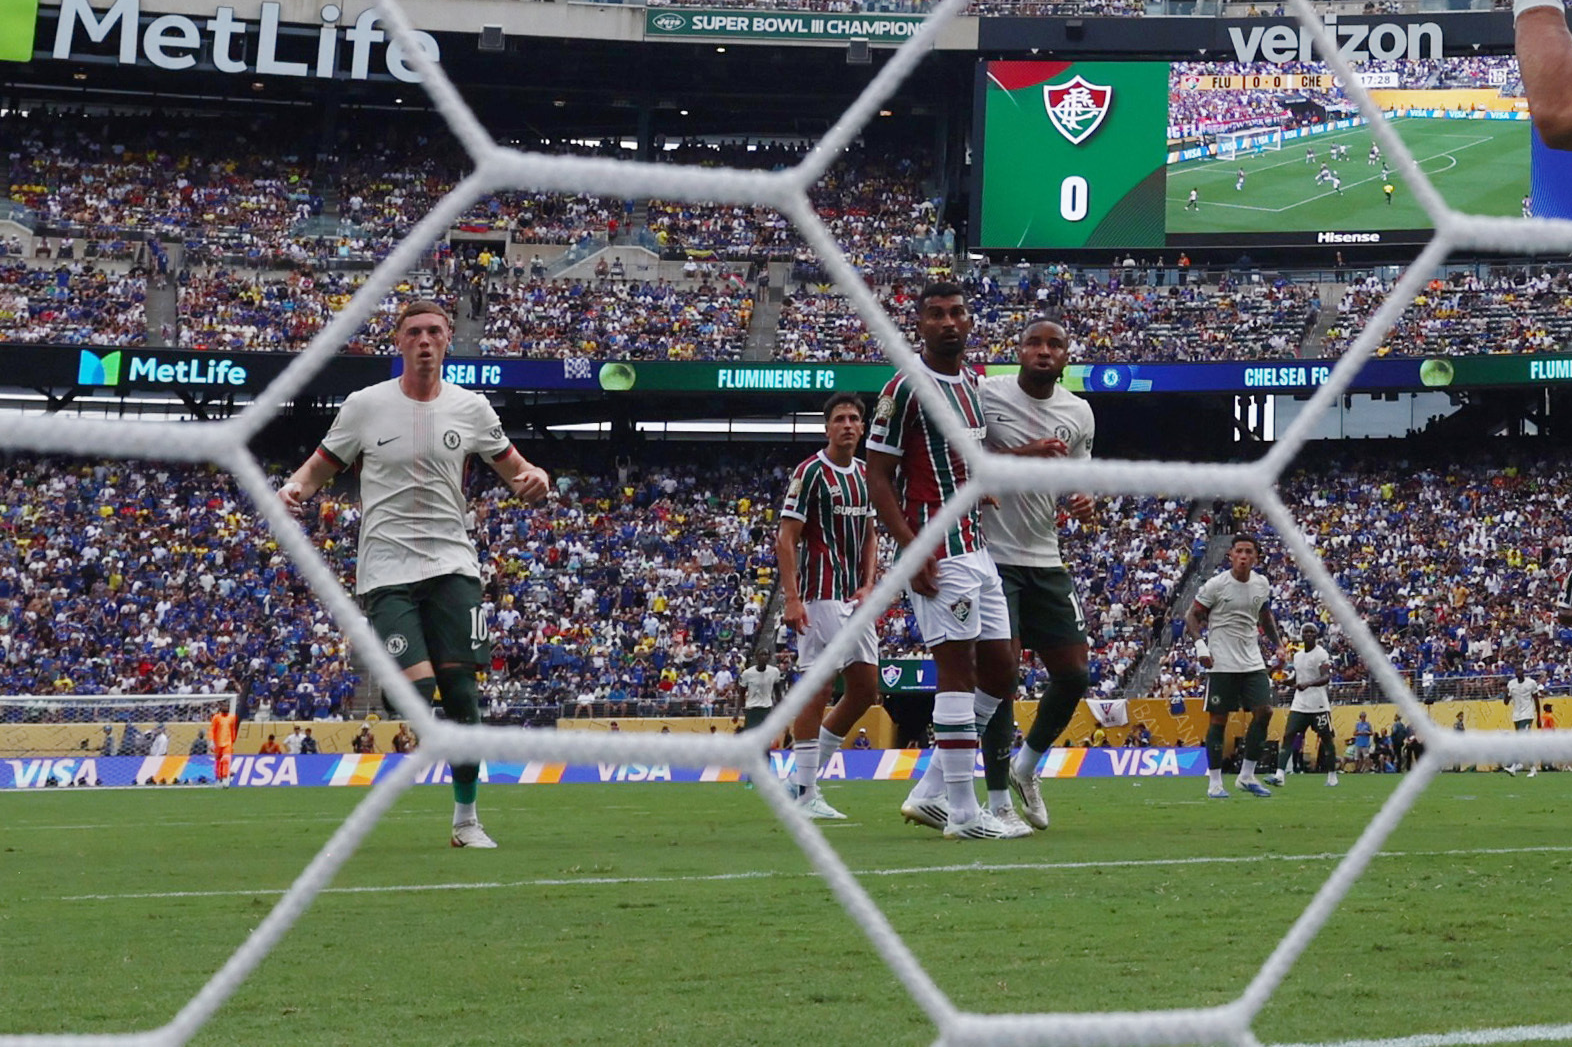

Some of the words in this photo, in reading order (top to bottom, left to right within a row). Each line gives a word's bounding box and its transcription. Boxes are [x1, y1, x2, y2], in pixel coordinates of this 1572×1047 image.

[692, 15, 749, 31] SUPER
[753, 18, 808, 33] BOWL
[811, 20, 824, 34] III
[1228, 14, 1443, 63] verizon
[1212, 76, 1231, 88] FLU
[1301, 75, 1322, 87] CHE
[1361, 75, 1391, 85] 17:28
[1408, 109, 1427, 118] VISA
[1183, 147, 1202, 159] VISA
[1060, 176, 1088, 221] 0
[1317, 232, 1380, 243] Hisense
[129, 357, 247, 385] MetLife
[481, 365, 501, 385] FC
[718, 369, 811, 388] FLUMINENSE
[816, 369, 834, 388] FC
[1244, 368, 1306, 386] CHELSEA
[1310, 367, 1329, 385] FC
[833, 505, 867, 516] SUPERB
[469, 607, 488, 641] 10
[916, 669, 924, 683] V
[414, 758, 490, 783] VIA
[597, 760, 672, 782] VISA
[769, 751, 847, 779] VA
[1102, 749, 1179, 776] VISA
[4, 758, 99, 788] VISA
